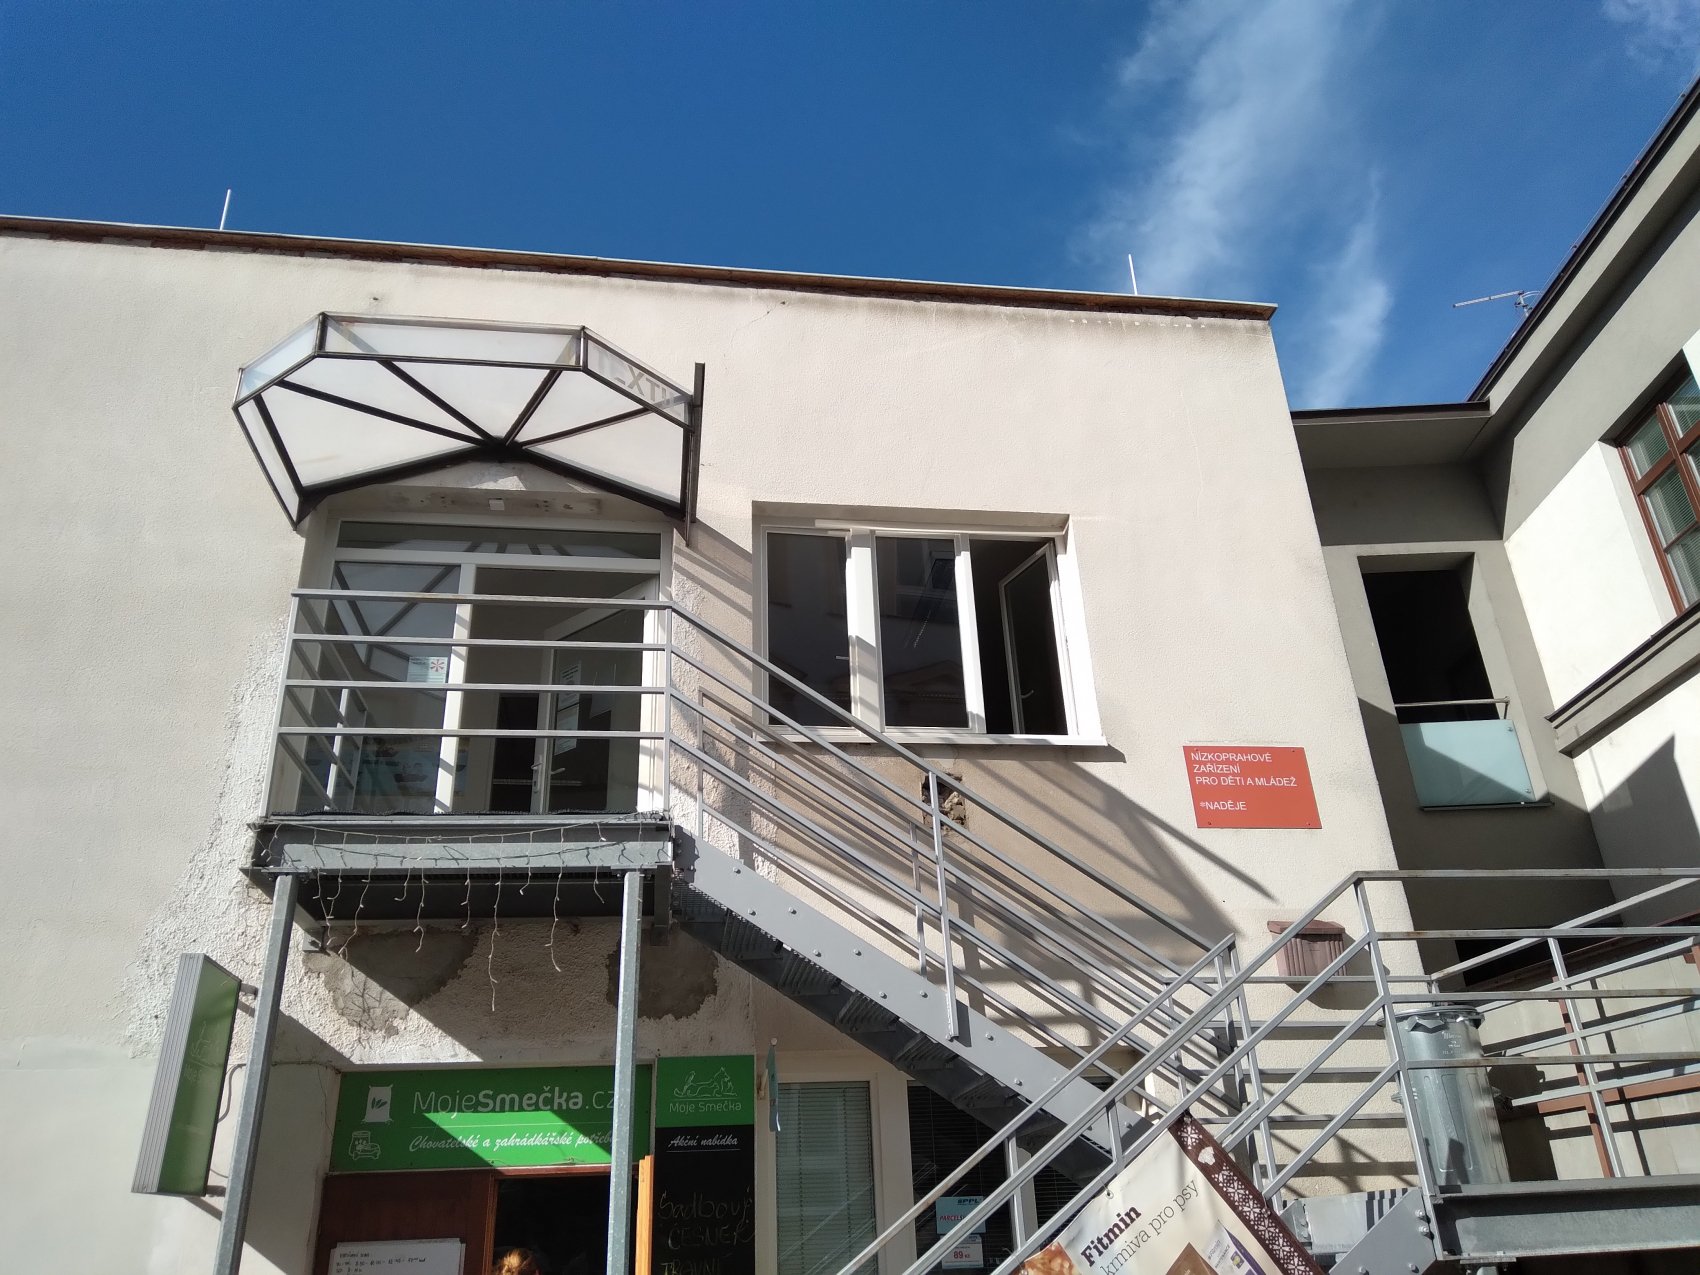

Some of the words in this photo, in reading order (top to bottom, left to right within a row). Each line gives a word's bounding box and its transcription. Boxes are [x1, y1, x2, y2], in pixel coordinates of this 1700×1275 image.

[1191, 751, 1273, 762] NÍZKOPRAHOVÉ
[1193, 763, 1240, 774] ZAŘÍZENÍ
[1195, 776, 1219, 786] PRO
[1220, 775, 1245, 786] DĚTI
[1246, 777, 1254, 786] A
[1255, 776, 1297, 787] MLÁDEŽ
[1205, 800, 1248, 811] NADĚJE
[412, 1086, 615, 1119] MojeSmečka.cz
[669, 1102, 696, 1114] Moje
[698, 1101, 742, 1112] Smečka
[408, 1134, 481, 1152] Chovatelské
[482, 1139, 491, 1148] a
[494, 1132, 573, 1152] zahrádkářské
[574, 1131, 613, 1149] potřeb
[667, 1135, 699, 1147] Akční
[700, 1133, 739, 1146] nabídka
[1100, 1229, 1151, 1275] krmiva
[1148, 1206, 1175, 1237] pro
[1173, 1180, 1199, 1213] psy
[1081, 1206, 1142, 1267] Fitmin
[953, 1250, 964, 1259] 89
